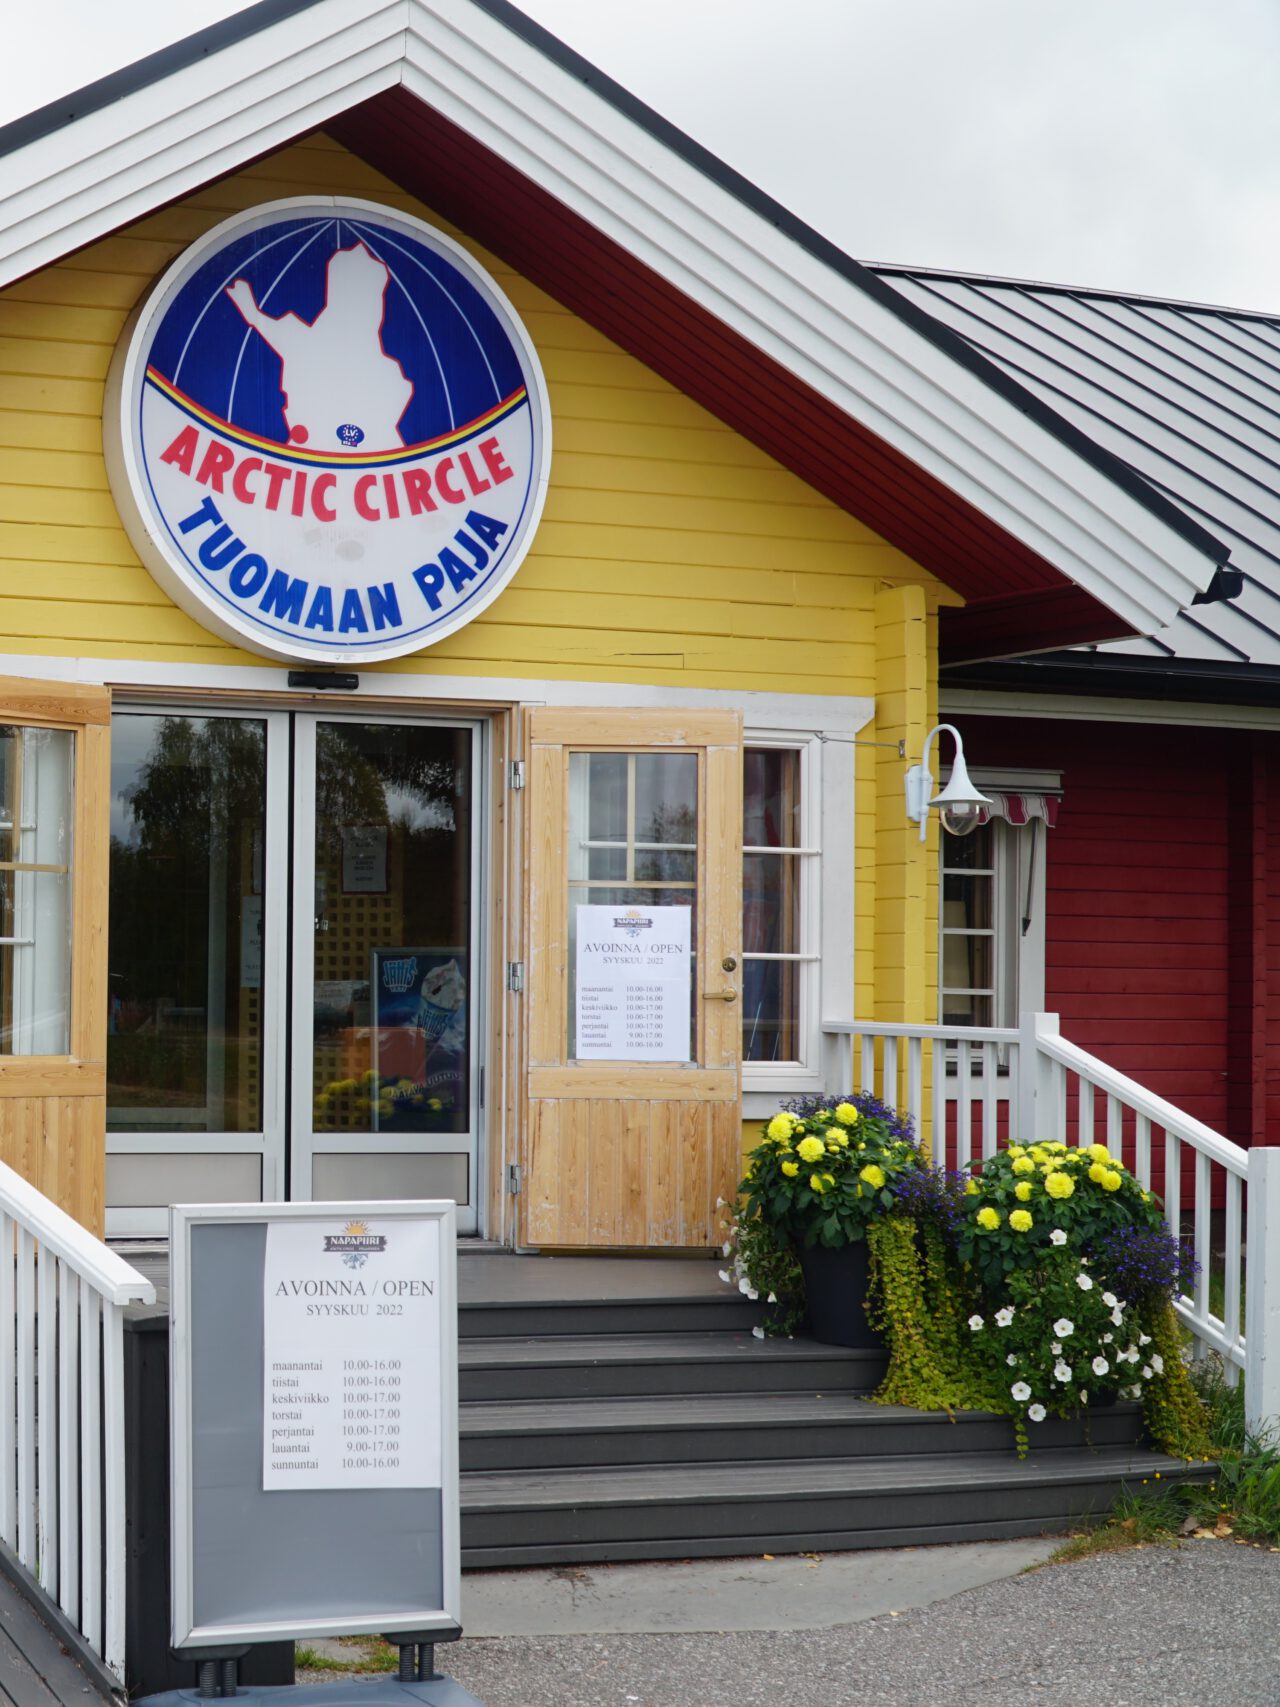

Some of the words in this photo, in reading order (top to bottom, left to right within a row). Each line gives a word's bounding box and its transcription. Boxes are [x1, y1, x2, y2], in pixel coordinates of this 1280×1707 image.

[161, 426, 337, 521] ARCTIC
[354, 437, 513, 521] CIRCLE
[179, 496, 403, 635] TUOMAAN
[412, 511, 508, 612] PAJA
[584, 943, 641, 953] AVOINNA
[650, 944, 684, 953] OPEN
[603, 957, 643, 965] SYYSKUU
[647, 957, 665, 965] 2022
[330, 1236, 380, 1245] NAPAPIIRI
[275, 1280, 367, 1296] AVOINNA
[372, 1280, 379, 1296] /
[382, 1280, 435, 1296] OPEN
[306, 1304, 369, 1316] SYYSKUU
[376, 1304, 403, 1316] 2022
[272, 1360, 323, 1371] maanantai
[343, 1359, 401, 1371] 10.00-16.00
[272, 1376, 299, 1387] tiistai
[343, 1376, 401, 1387] 10.00-16.00
[272, 1392, 330, 1404] keskiviikko
[343, 1392, 401, 1403] 10.00-17.00
[272, 1409, 302, 1420] torstai
[343, 1408, 400, 1420] 10.00-17.00
[272, 1425, 315, 1439] perjantai
[343, 1425, 400, 1436] 10.00-17.00
[272, 1442, 310, 1453] lauantai
[346, 1441, 399, 1452] 9.00-17.00
[271, 1459, 319, 1471] sunnuntai
[342, 1458, 400, 1469] 10.00-16.00
